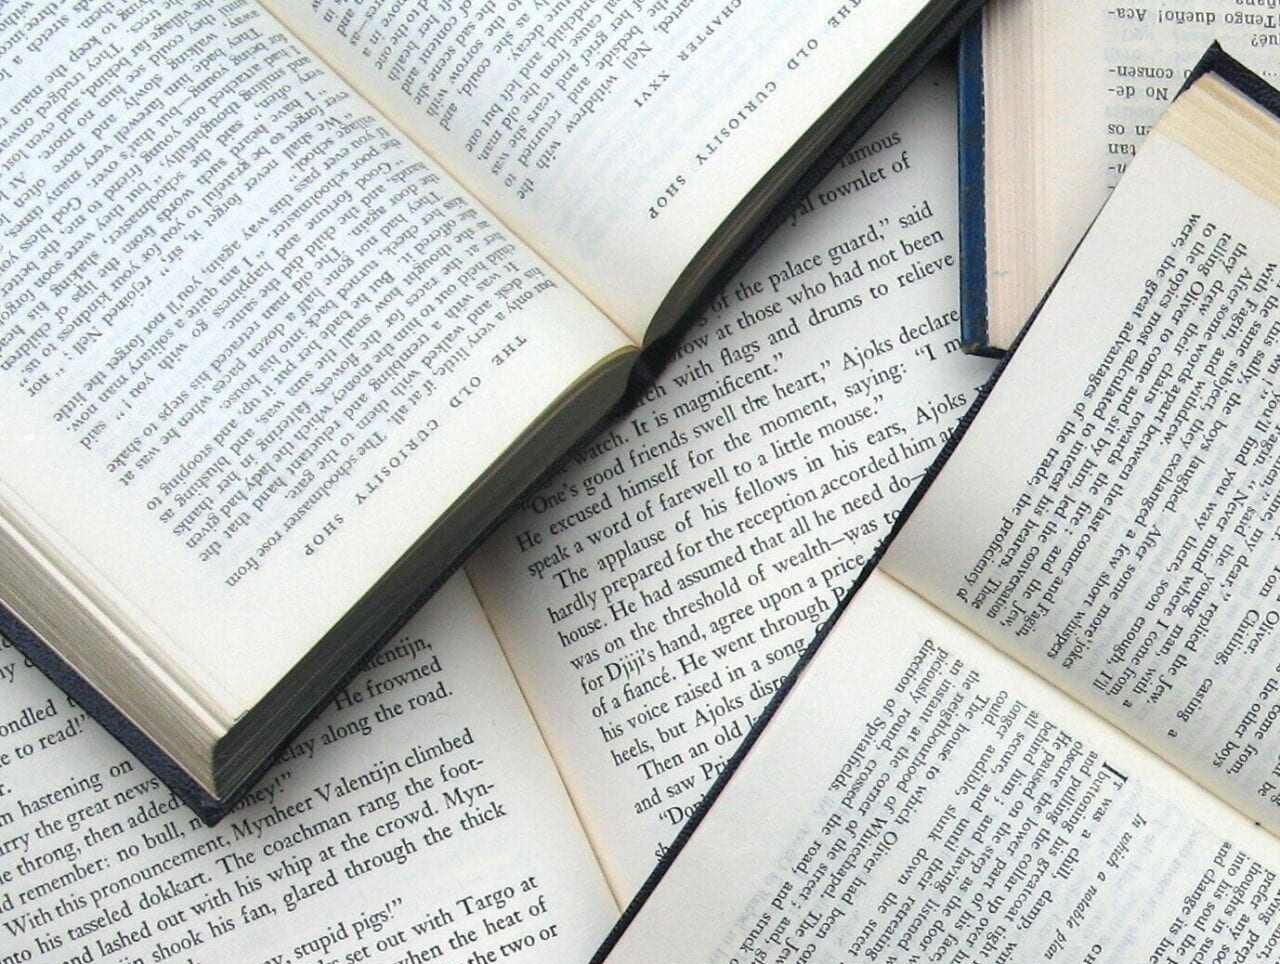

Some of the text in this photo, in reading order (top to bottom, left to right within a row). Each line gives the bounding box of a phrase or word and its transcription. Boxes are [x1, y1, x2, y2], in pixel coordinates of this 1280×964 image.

[786, 38, 819, 70] OLD
[632, 69, 671, 109] XXVI
[695, 80, 777, 166] CURIOSITY
[647, 174, 687, 220] SHOP
[218, 207, 446, 409] her cheek, turned back into his house.
[1159, 262, 1278, 446] with Fagin, and withdrew.
[303, 335, 528, 556] THE OLD CURIOSITY SHOP
[516, 362, 907, 552] He excused himself for the moment, saying:
[528, 544, 571, 577] speak
[573, 541, 585, 554] a
[585, 510, 633, 545] word
[635, 499, 655, 523] of
[658, 465, 730, 512] farewell
[732, 460, 752, 477] to
[756, 453, 769, 467] a
[769, 430, 814, 459] little
[827, 715, 887, 791] Spitalfields.
[924, 765, 940, 780] to
[893, 785, 928, 825] which
[1130, 812, 1148, 829] In
[4, 726, 475, 937] With this pronouncement, Mynheer Valentijn climbed
[862, 830, 899, 874] Oliver
[1105, 831, 1133, 869] which
[840, 876, 867, 906] had
[1096, 870, 1107, 882] a
[814, 906, 846, 939] been
[1065, 884, 1098, 929] notable
[293, 921, 350, 960] stupid
[1043, 927, 1067, 960] plan
